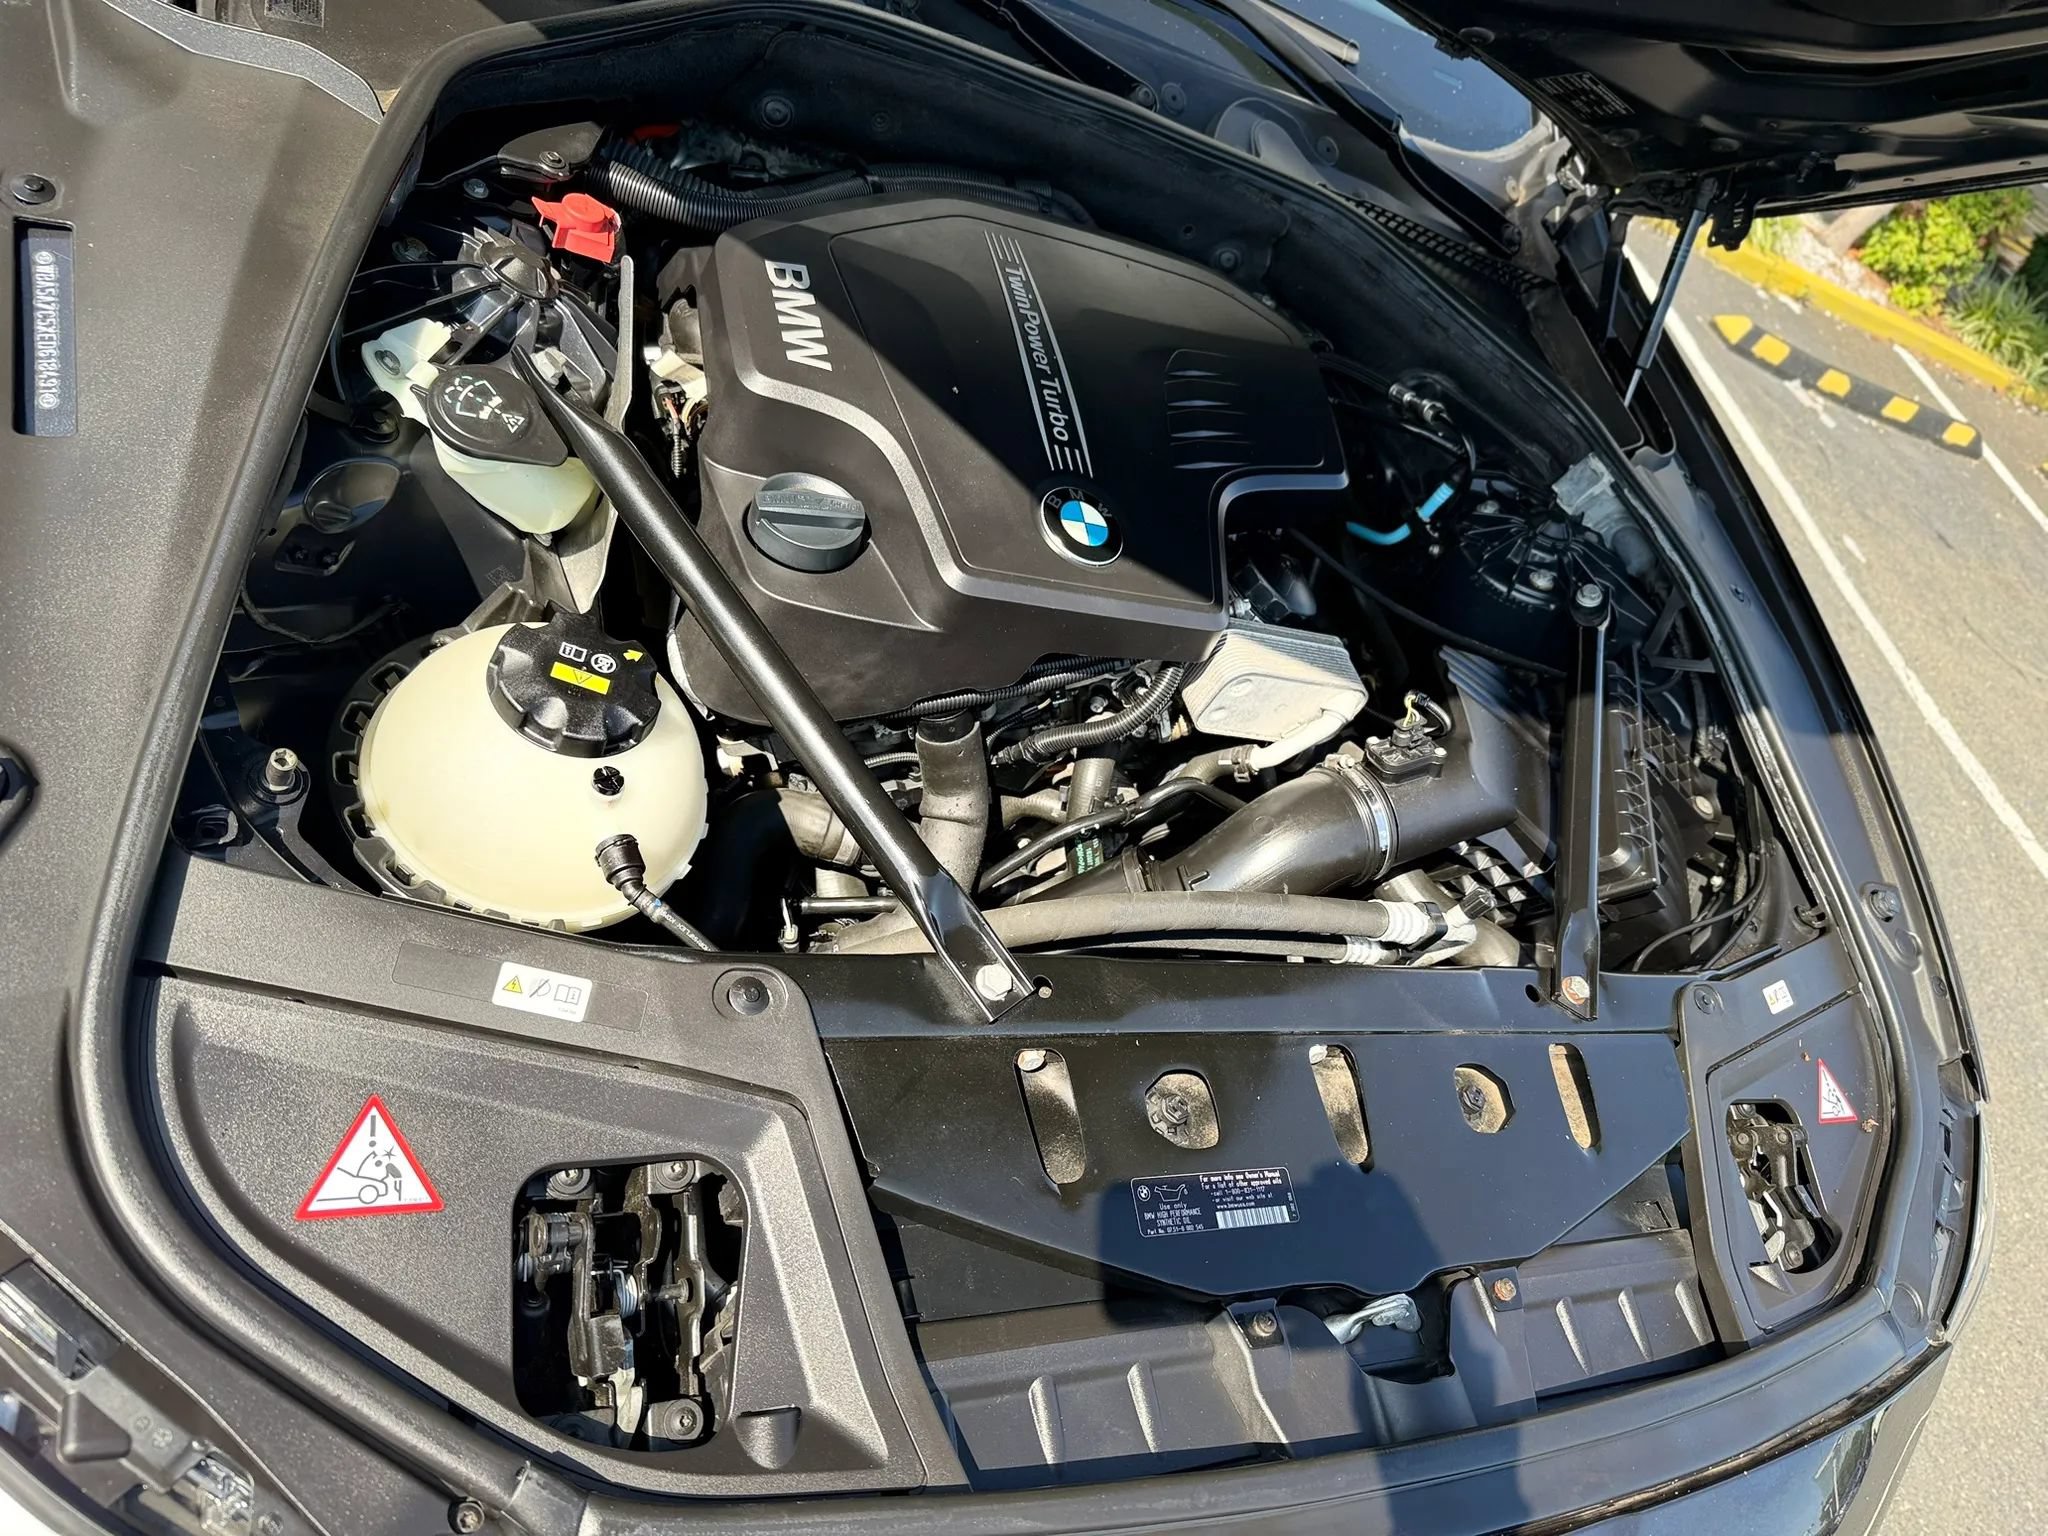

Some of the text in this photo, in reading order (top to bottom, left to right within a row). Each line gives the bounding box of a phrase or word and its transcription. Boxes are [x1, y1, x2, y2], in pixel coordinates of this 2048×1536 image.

[764, 259, 832, 371] BMW
[1005, 267, 1068, 441] TwinPower Turbo
[1144, 1207, 1202, 1220] BMW HIGH PERFORMANCE
[1156, 1218, 1181, 1227] SYNTHETIC
